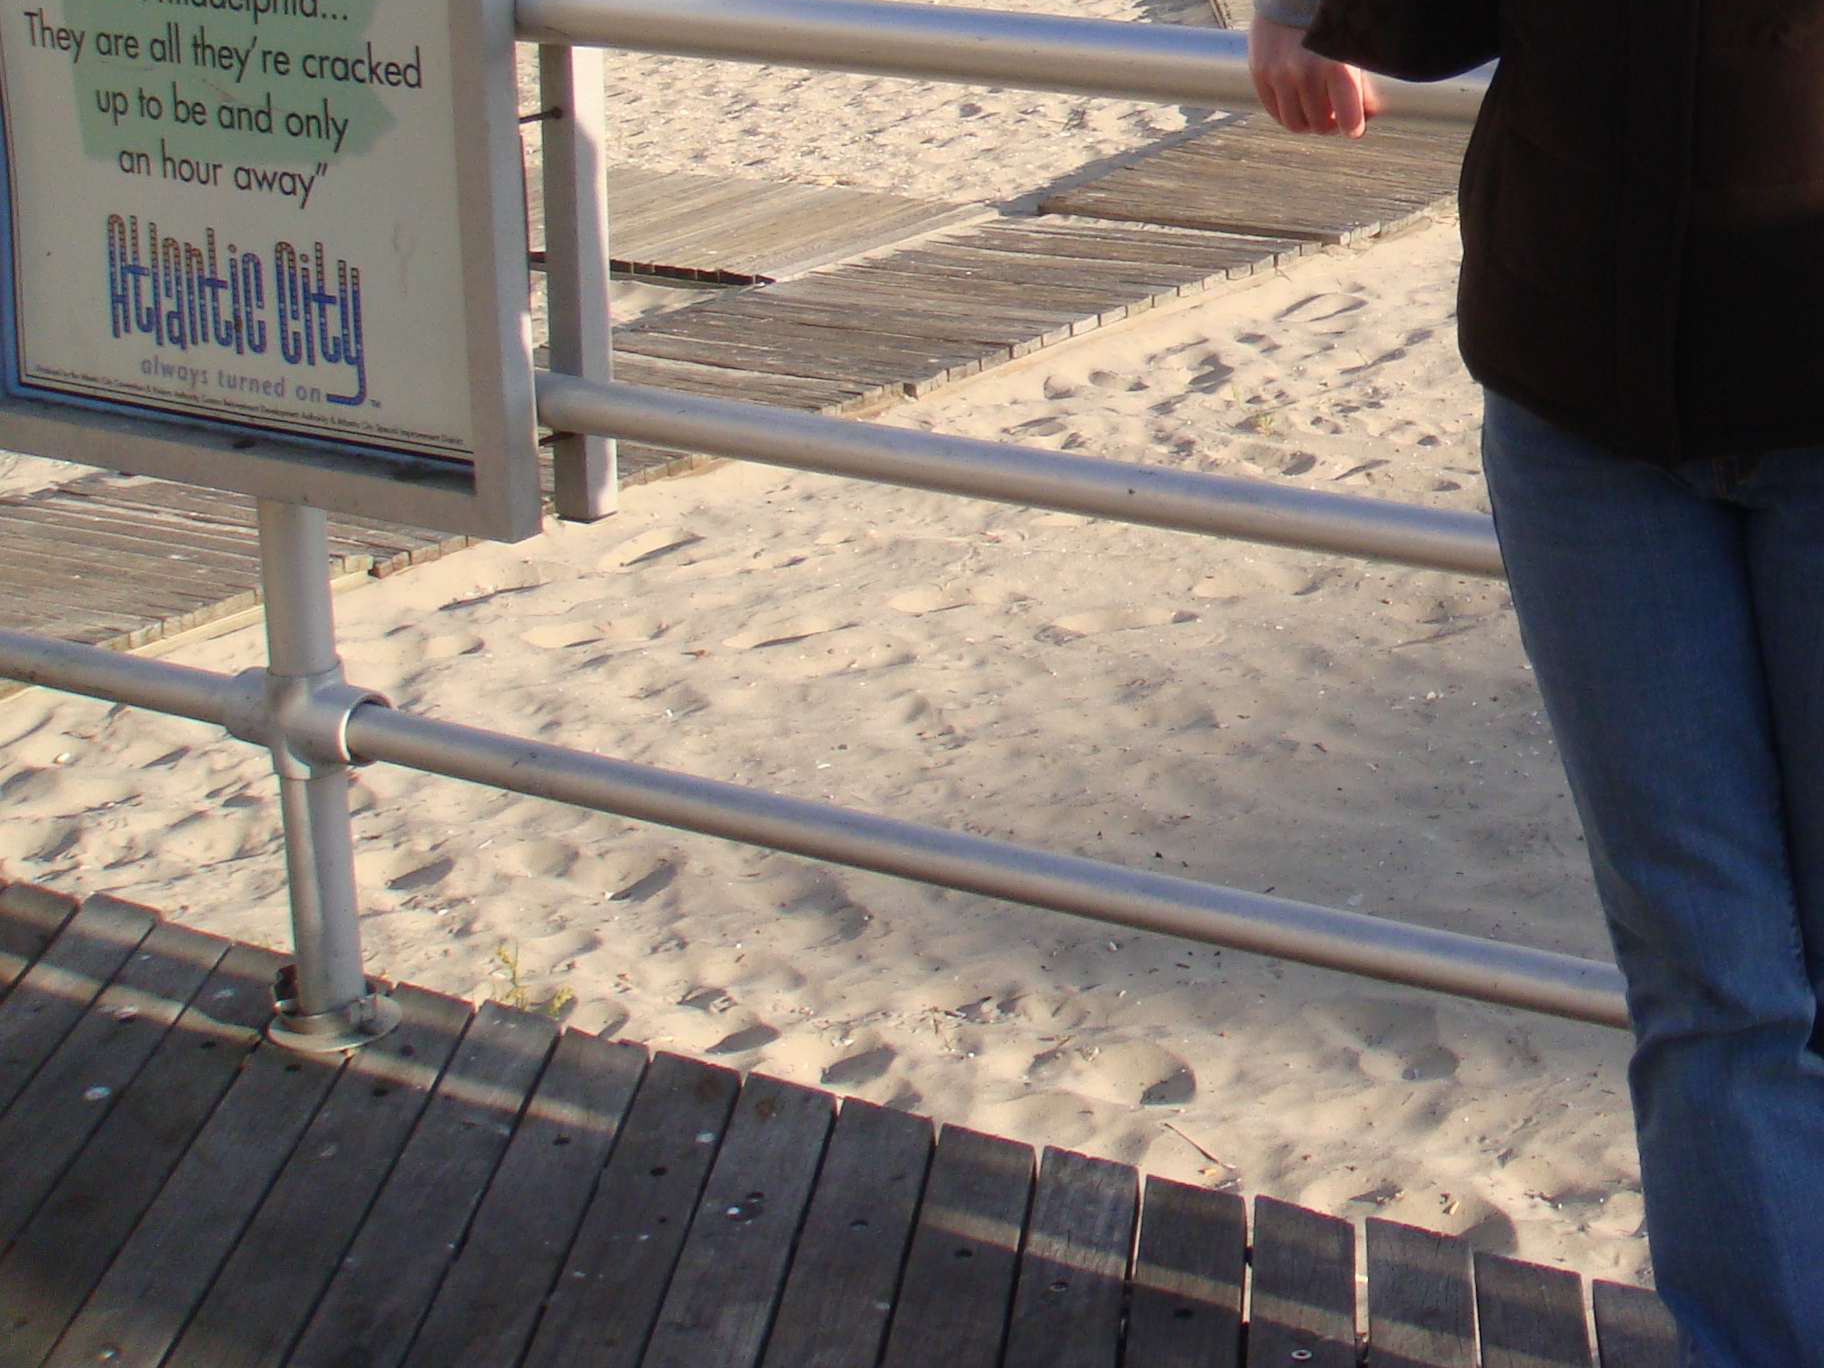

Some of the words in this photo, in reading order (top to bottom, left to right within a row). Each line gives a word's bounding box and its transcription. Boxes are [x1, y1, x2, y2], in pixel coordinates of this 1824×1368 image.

[24, 7, 86, 64] They
[96, 32, 140, 60] are
[150, 21, 182, 63] all
[192, 24, 291, 83] they're
[302, 41, 422, 89] cracked
[96, 89, 129, 126] up
[138, 87, 163, 120] to
[172, 81, 207, 126] be
[218, 91, 273, 134] and
[286, 97, 348, 154] only
[119, 149, 151, 176] an
[161, 137, 223, 186] hour
[234, 162, 328, 210] away"
[107, 213, 267, 355] Atlantic
[275, 241, 367, 406] City
[140, 355, 209, 387] always
[218, 369, 286, 398] turned
[295, 384, 322, 403] on
